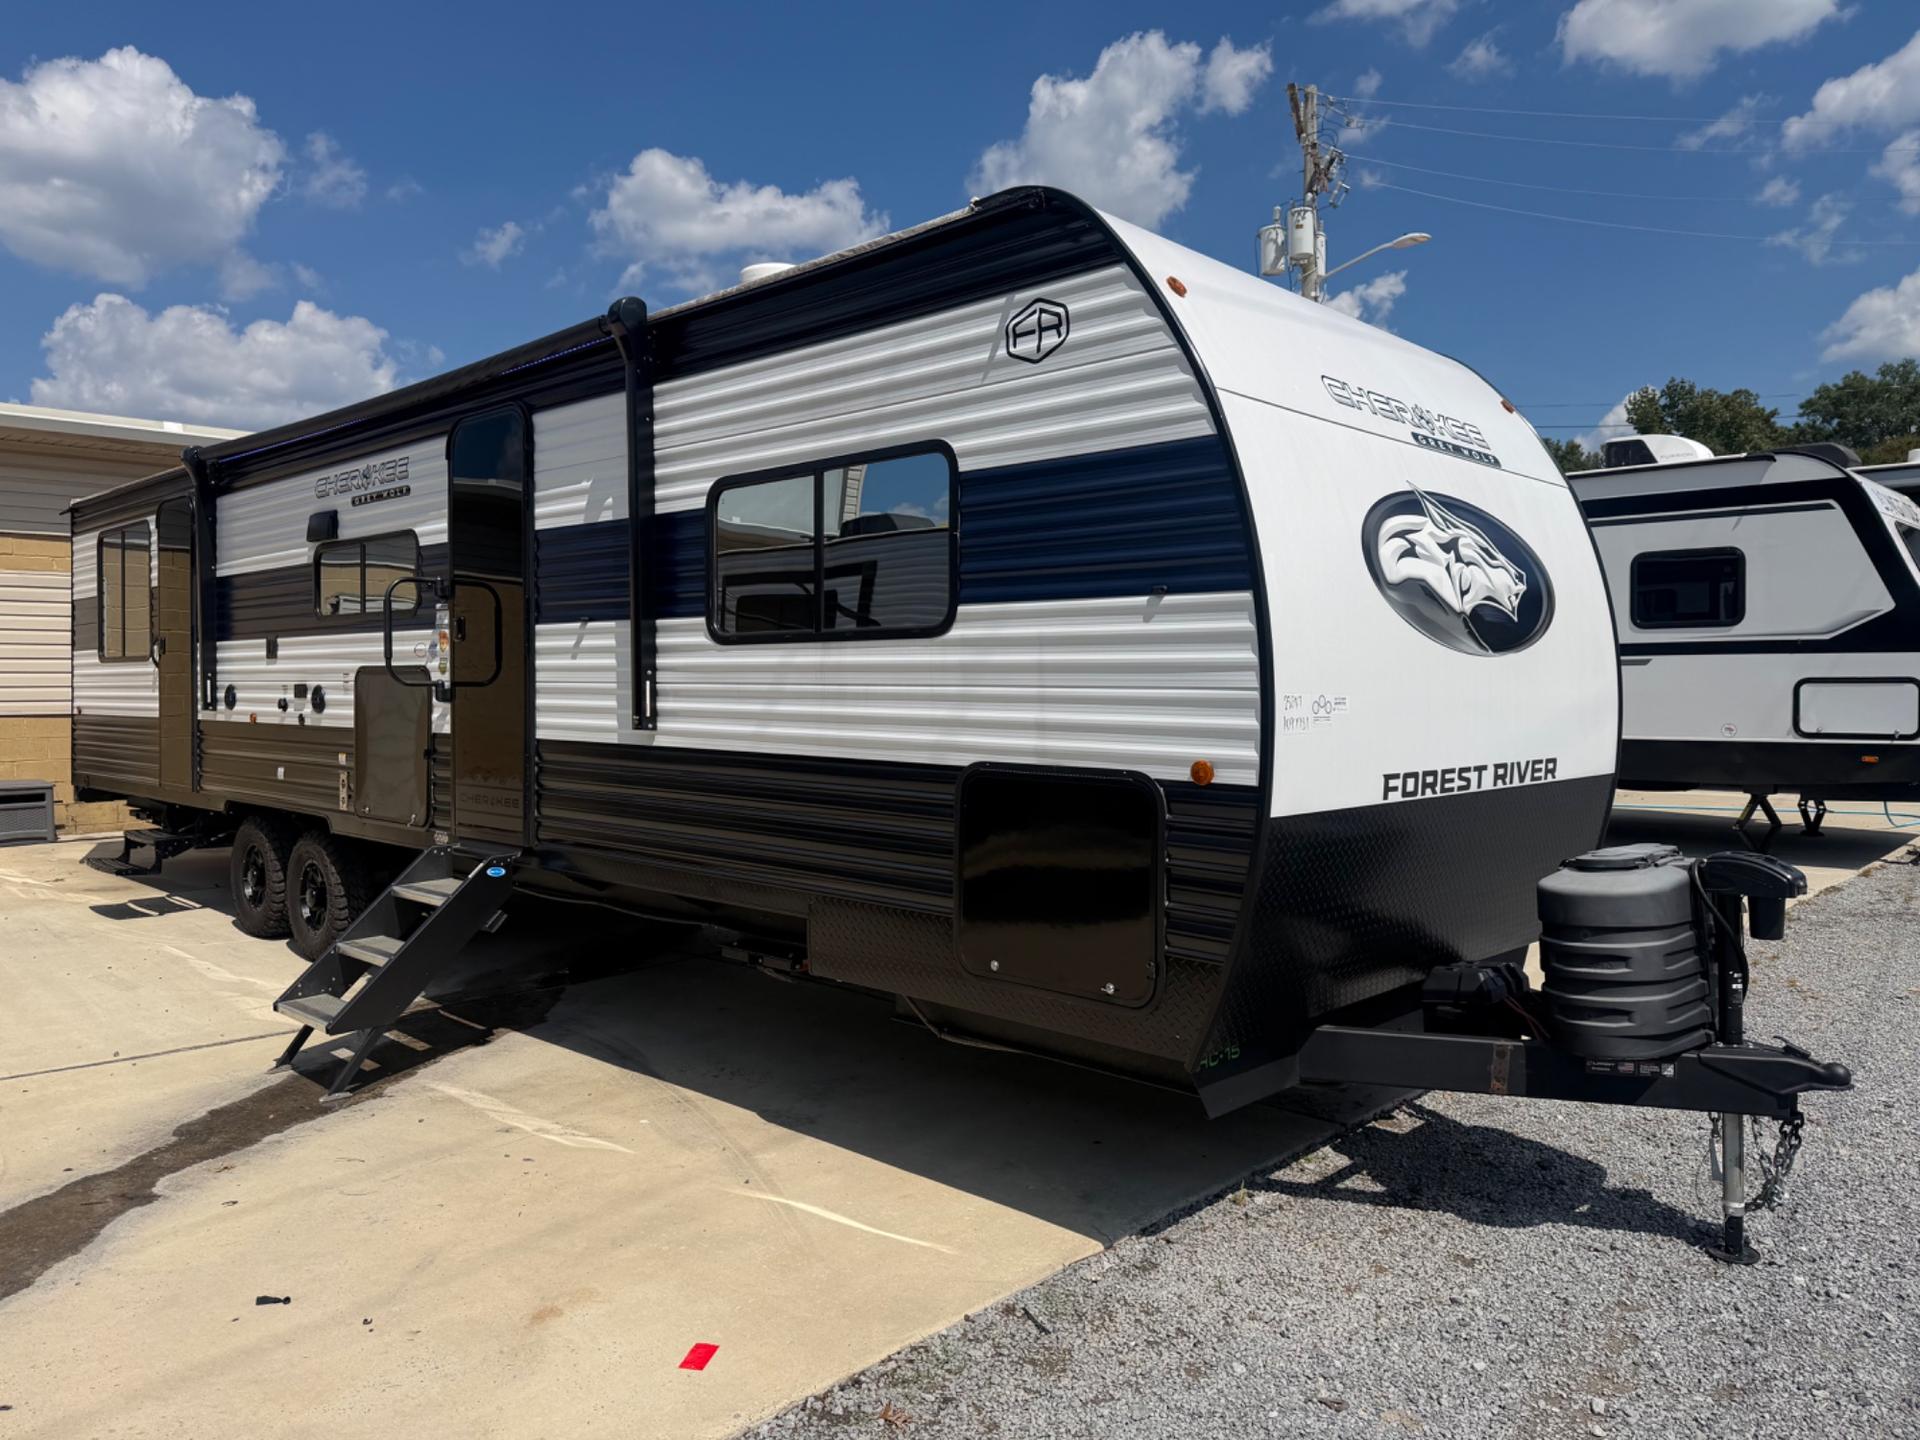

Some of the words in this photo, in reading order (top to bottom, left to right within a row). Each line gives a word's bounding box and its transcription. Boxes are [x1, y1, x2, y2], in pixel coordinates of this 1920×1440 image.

[1320, 374, 1491, 450] CHEROKEE
[1417, 434, 1454, 452] GREY
[1460, 447, 1495, 464] WOLF
[314, 456, 409, 499] CHEROKEE
[1382, 764, 1488, 801] FOREST
[1493, 757, 1558, 787] RIVER
